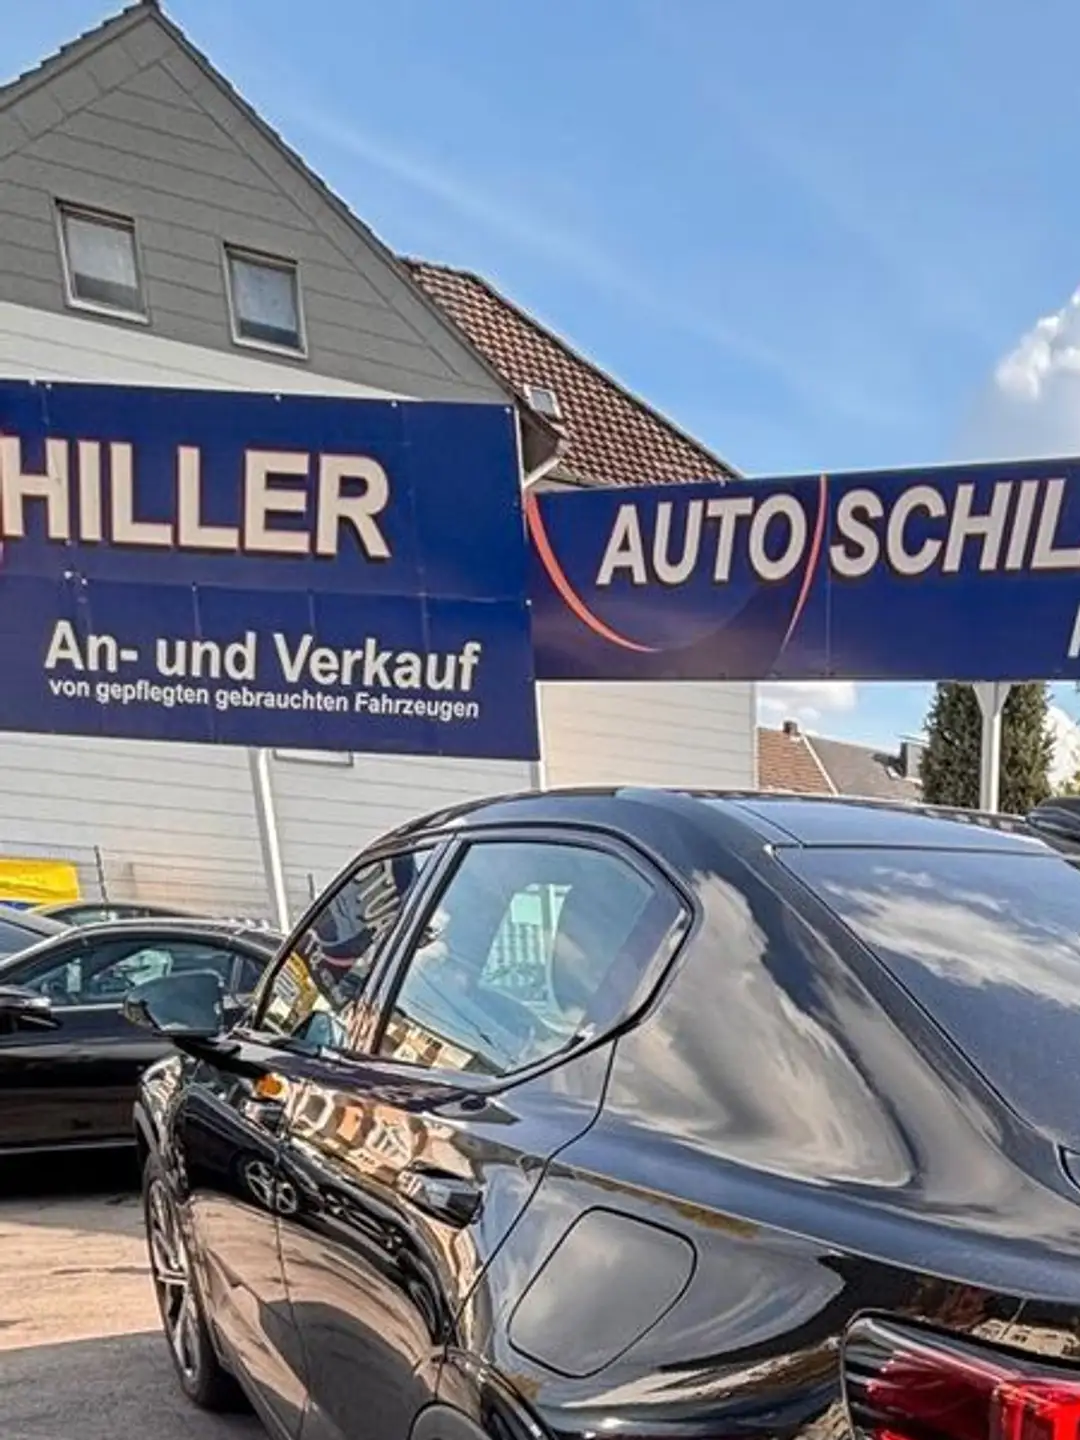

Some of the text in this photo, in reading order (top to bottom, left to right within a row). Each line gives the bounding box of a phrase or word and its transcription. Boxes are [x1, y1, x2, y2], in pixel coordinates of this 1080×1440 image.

[0, 436, 392, 559] HILLER
[596, 493, 807, 585] AUTO
[44, 619, 482, 692] An- und Verkauf
[50, 678, 480, 721] von gepflegten gebrauchten Fahrzeugen
